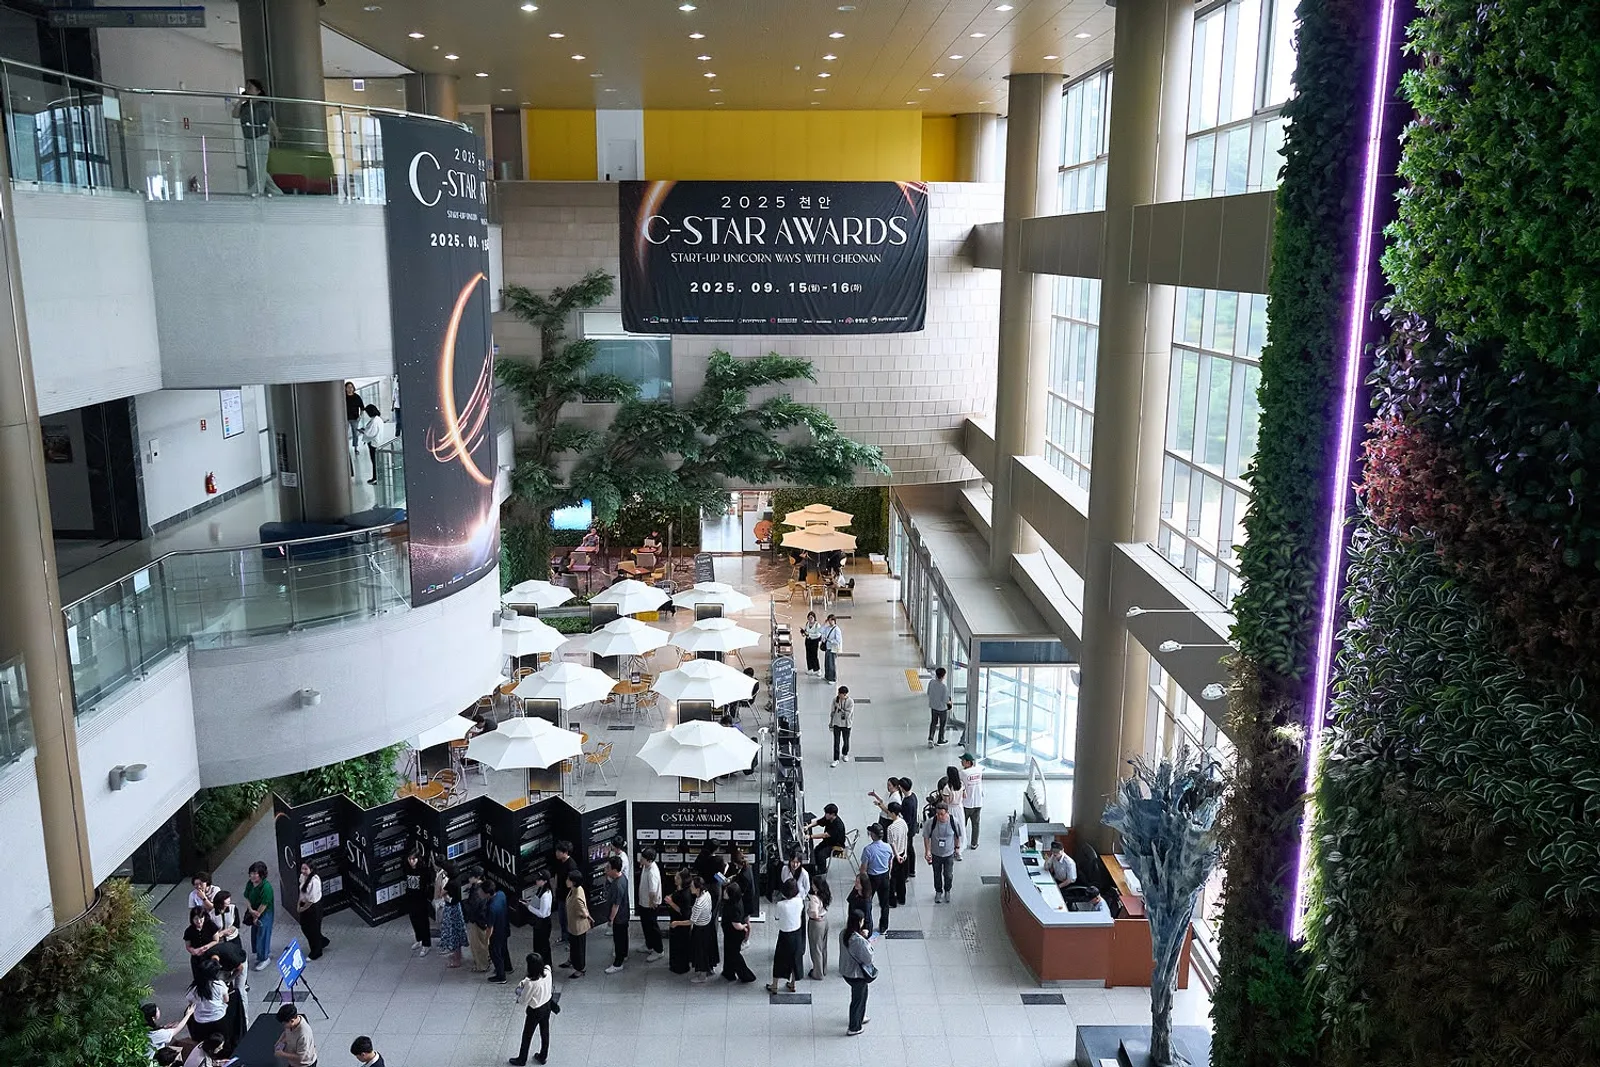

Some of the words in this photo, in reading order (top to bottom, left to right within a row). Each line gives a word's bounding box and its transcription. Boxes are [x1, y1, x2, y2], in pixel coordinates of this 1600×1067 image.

[454, 148, 476, 165] 2025
[408, 151, 477, 207] C-STAR
[721, 196, 786, 210] 2025
[798, 195, 832, 210] 천안
[642, 214, 767, 246] C-STAR
[774, 215, 908, 246] AWARDS
[430, 232, 465, 249] 2025.
[468, 235, 480, 248] 09.
[670, 252, 721, 264] START-UP
[723, 252, 773, 264] UNICORN
[774, 252, 802, 264] WAYS
[804, 252, 830, 264] WITH
[832, 252, 882, 264] CHEONAN
[689, 281, 743, 294] 2025.
[750, 281, 780, 294] 09.
[660, 812, 695, 823] C-STAR
[695, 812, 733, 823] AWARDS
